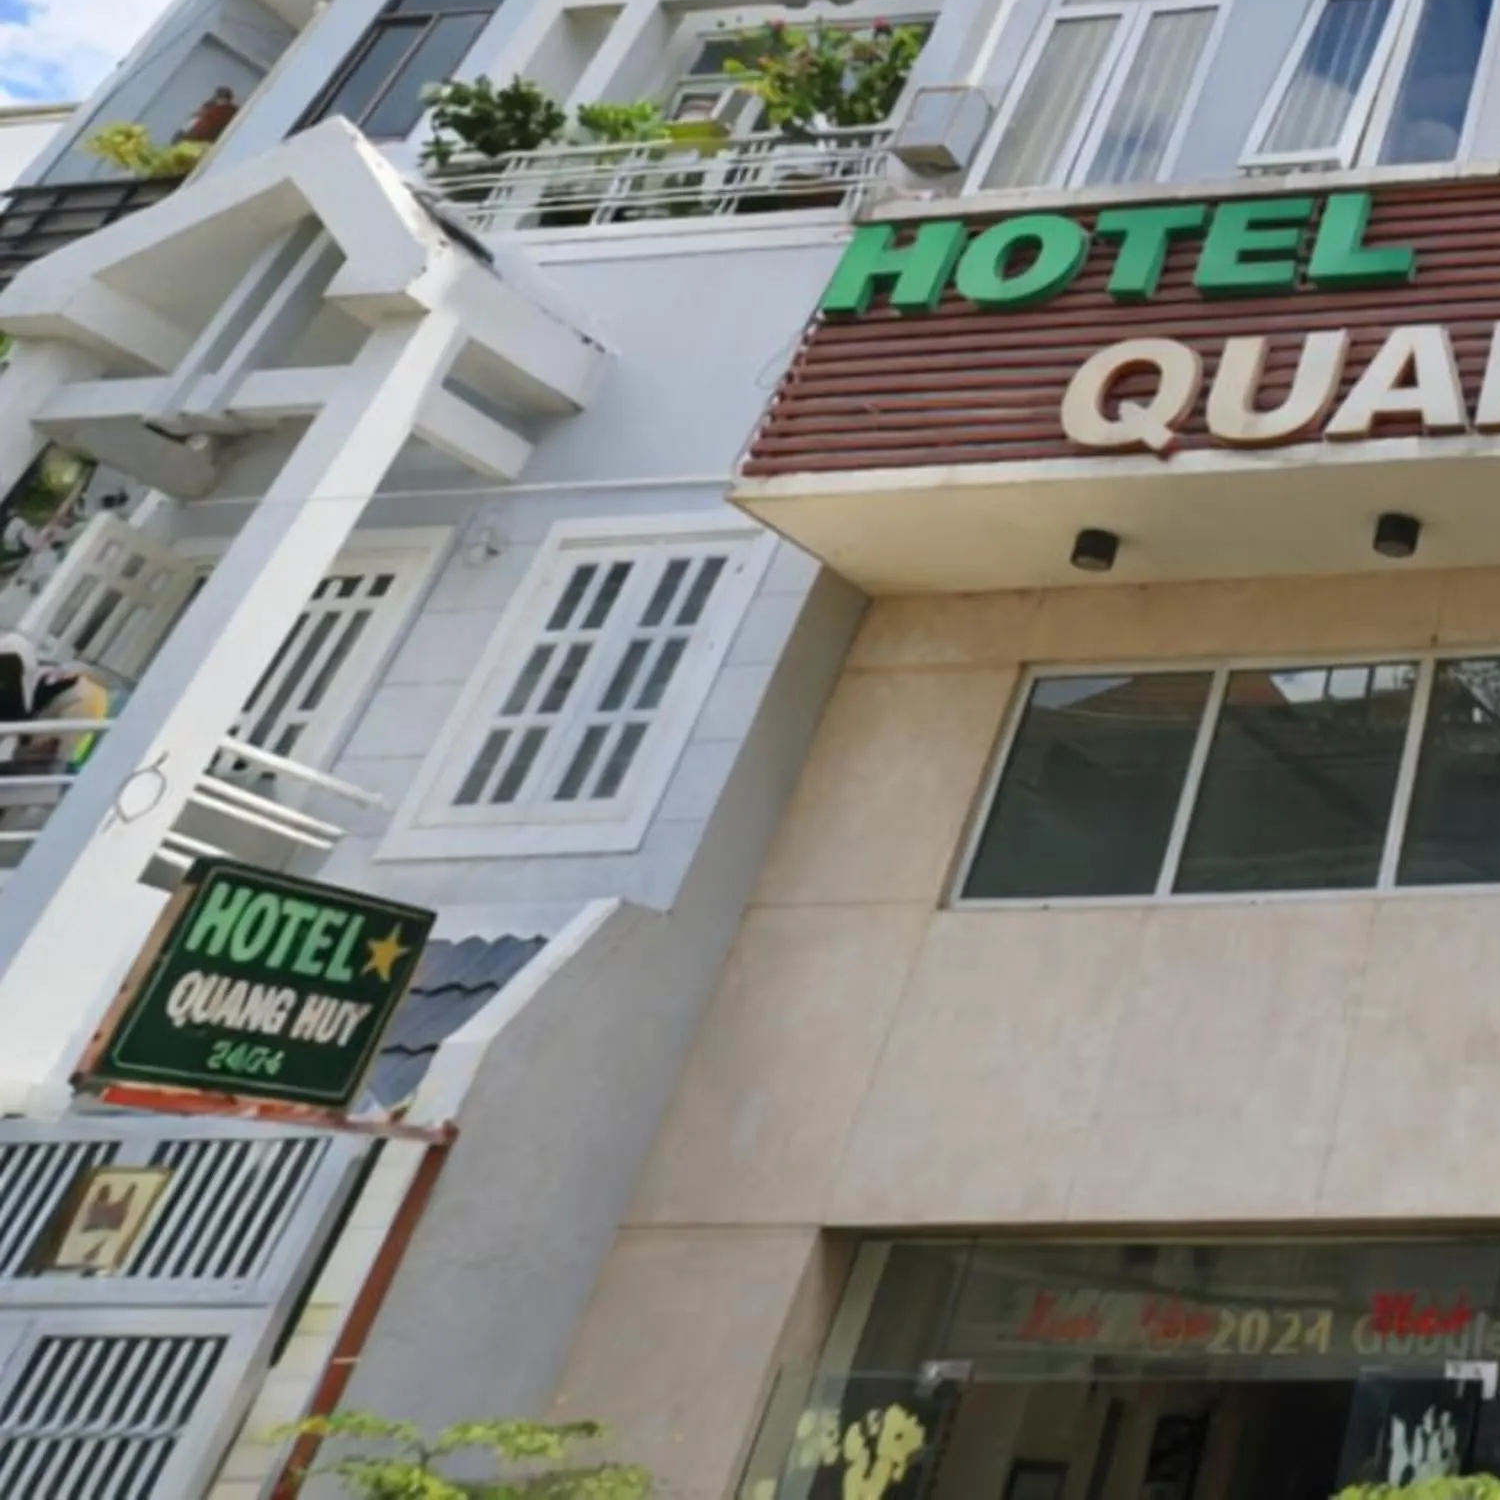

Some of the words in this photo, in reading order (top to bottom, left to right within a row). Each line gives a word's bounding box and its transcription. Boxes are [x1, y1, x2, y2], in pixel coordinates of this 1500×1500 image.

[821, 192, 1417, 316] HOTEL
[185, 880, 366, 983] HOTEL
[166, 969, 298, 1036] QUANG
[289, 992, 373, 1049] HUY
